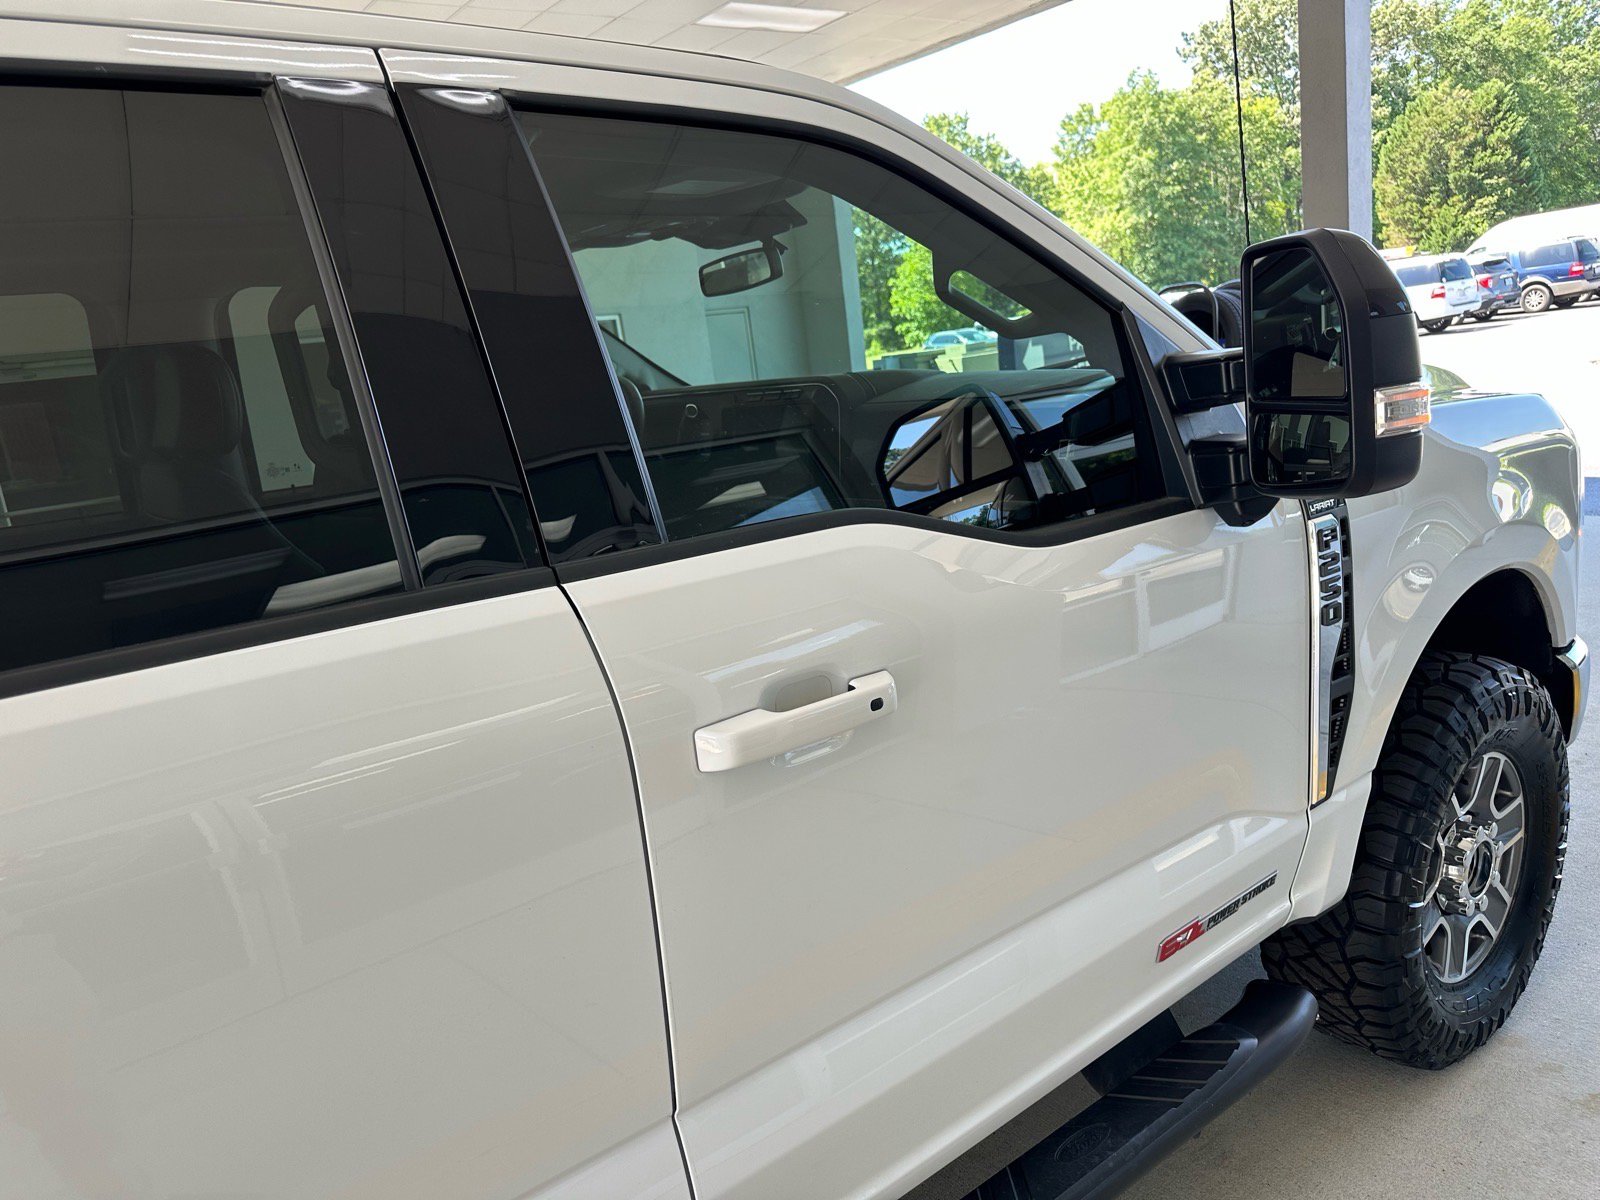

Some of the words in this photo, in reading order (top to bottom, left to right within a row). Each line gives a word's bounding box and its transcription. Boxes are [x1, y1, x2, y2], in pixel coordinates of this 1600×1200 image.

[1309, 498, 1335, 512] LARIAT
[1316, 527, 1342, 627] F250
[1206, 897, 1241, 929] POWER
[1241, 873, 1278, 905] STROKE
